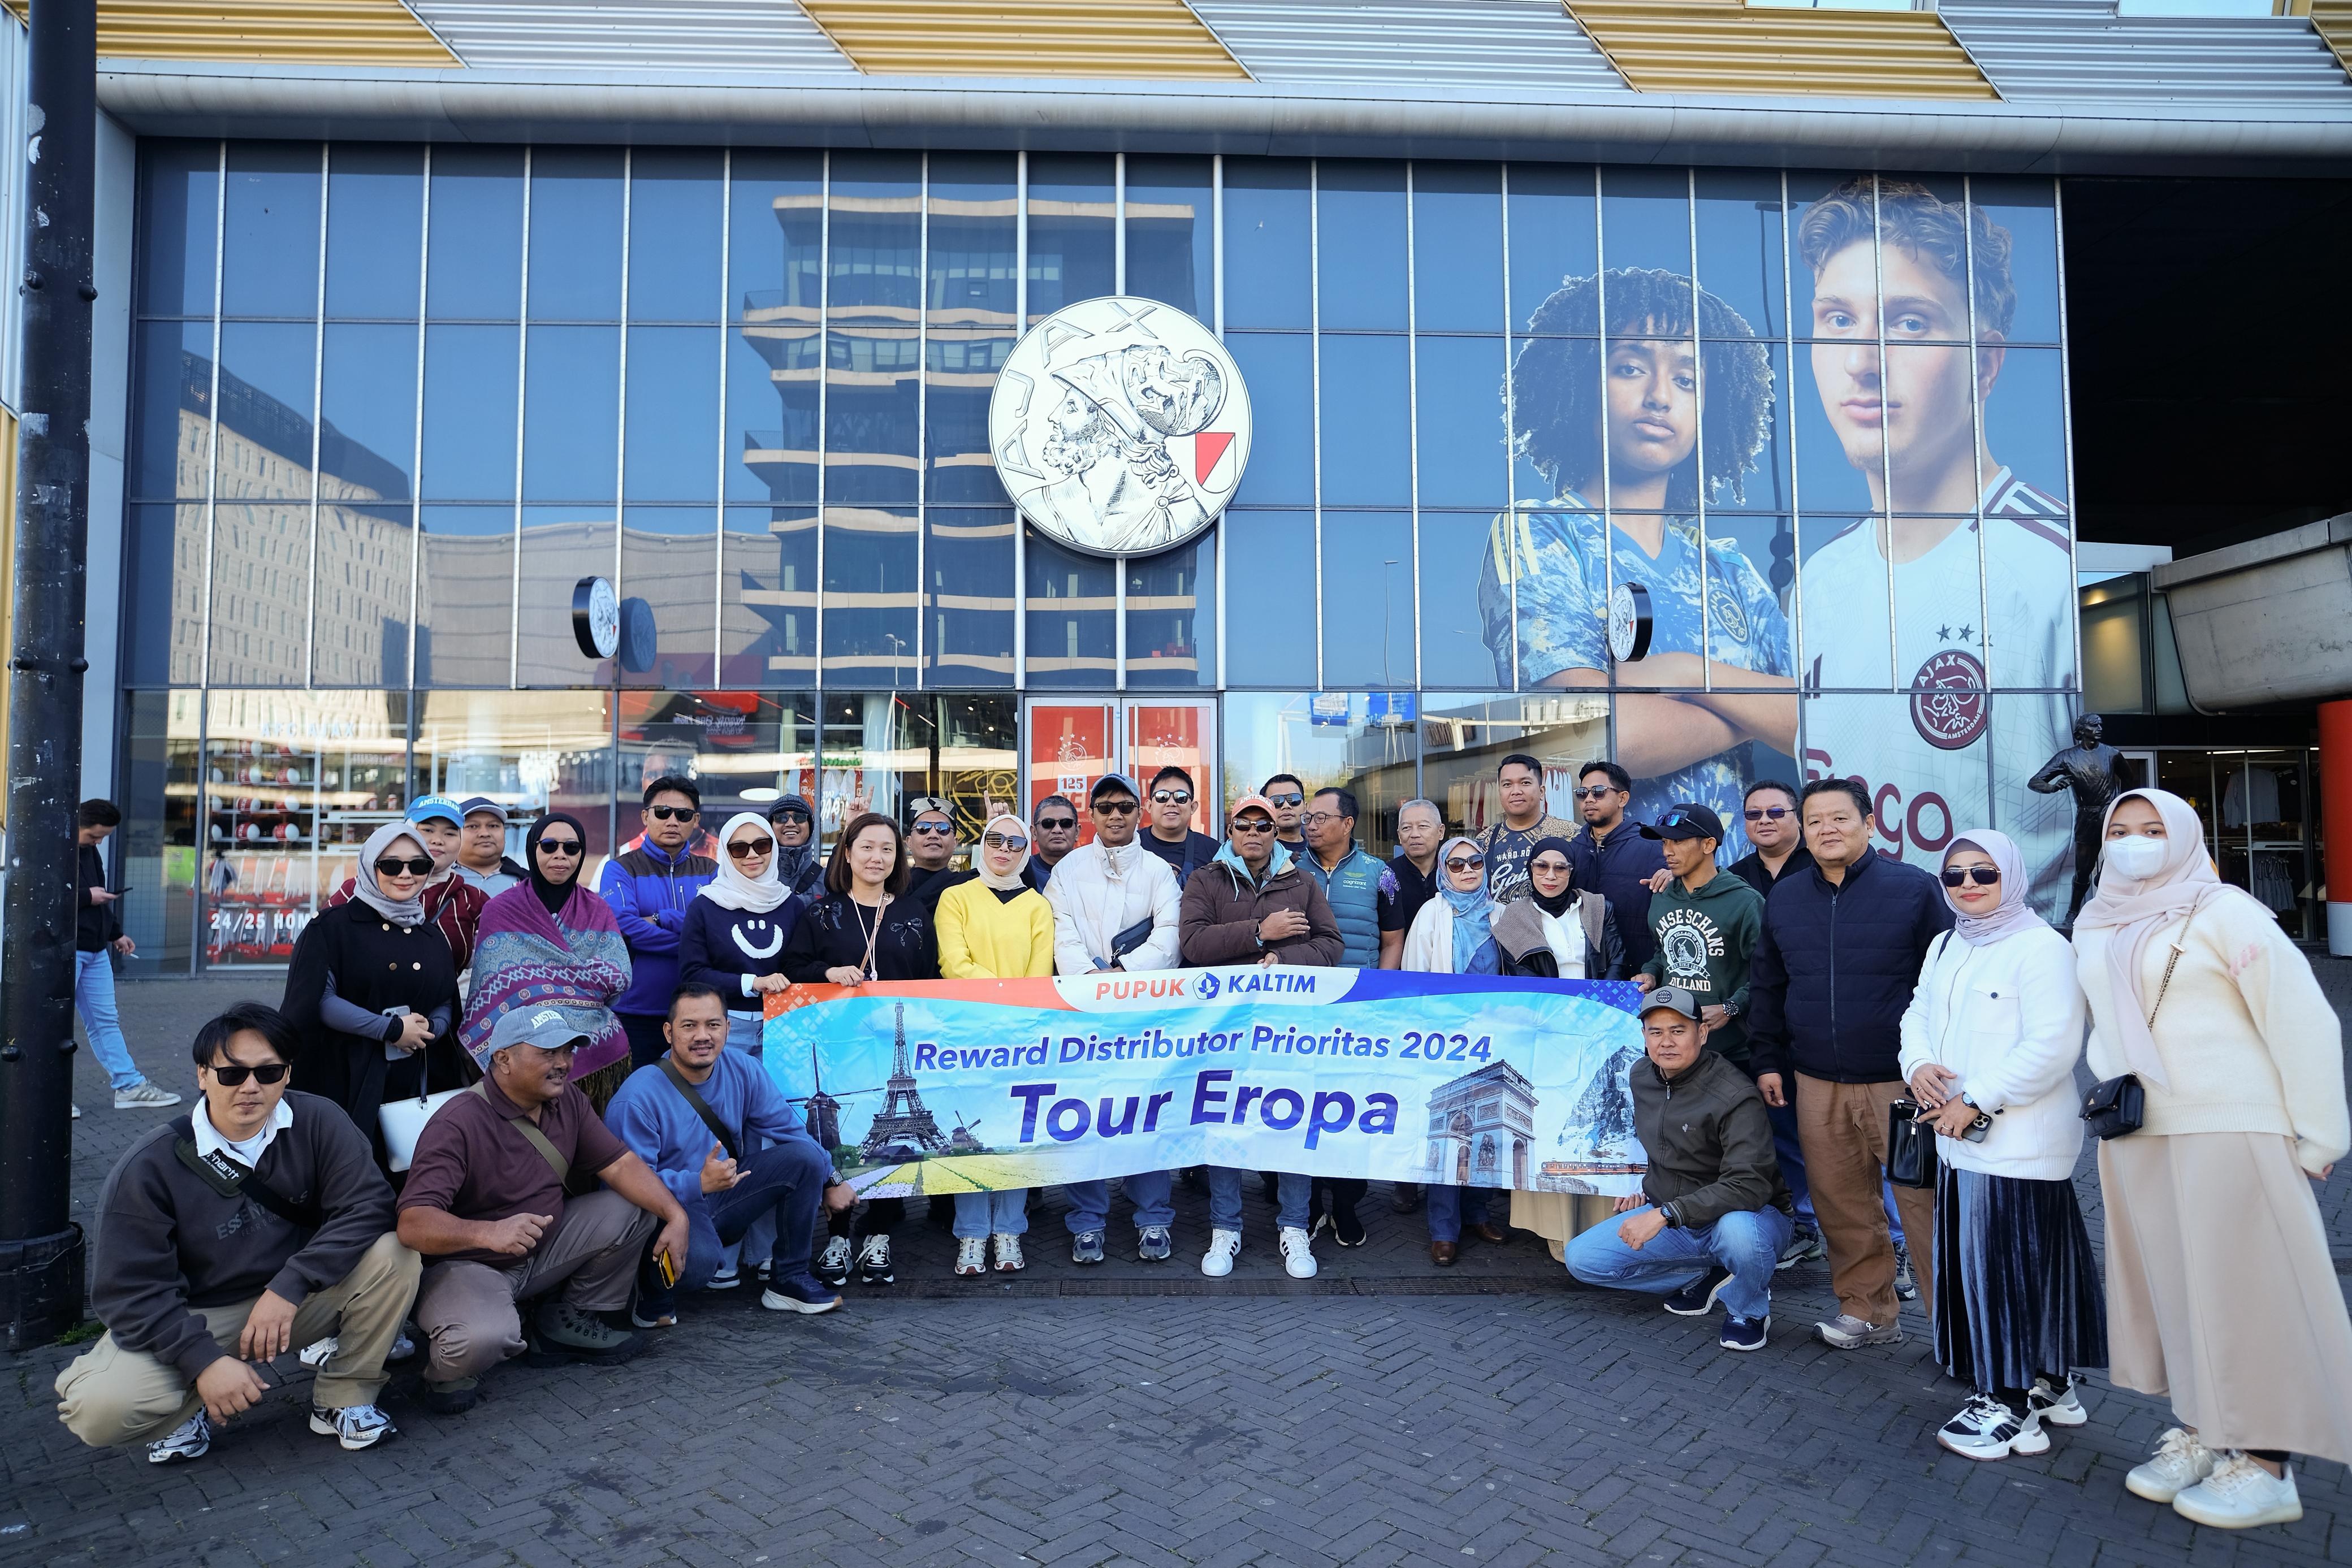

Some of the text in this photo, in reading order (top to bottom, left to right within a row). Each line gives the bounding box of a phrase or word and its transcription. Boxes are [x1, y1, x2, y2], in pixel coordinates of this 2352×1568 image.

[998, 302, 1158, 480] AJAX
[1918, 655, 1956, 687] AJAX
[262, 722, 354, 737] AFC AJAX
[1947, 712, 1981, 739] AMSTERDAM
[1058, 741, 1071, 756] AJAX
[1061, 777, 1083, 789] 125
[418, 796, 460, 815] AMSTERDAM
[1239, 795, 1272, 809] AMSTERDAM
[1497, 851, 1517, 862] HARD
[211, 913, 312, 933] 24/25 HOM
[1685, 909, 1724, 956] SCHANS
[1096, 974, 1316, 1000] PUPUK KALTIM
[915, 1026, 1493, 1071] Reward Distributor Prioritas 2024
[1010, 1069, 1399, 1150] Tour Eropa
[207, 1153, 239, 1180] rhartt
[210, 1164, 227, 1180] PROGRESS
